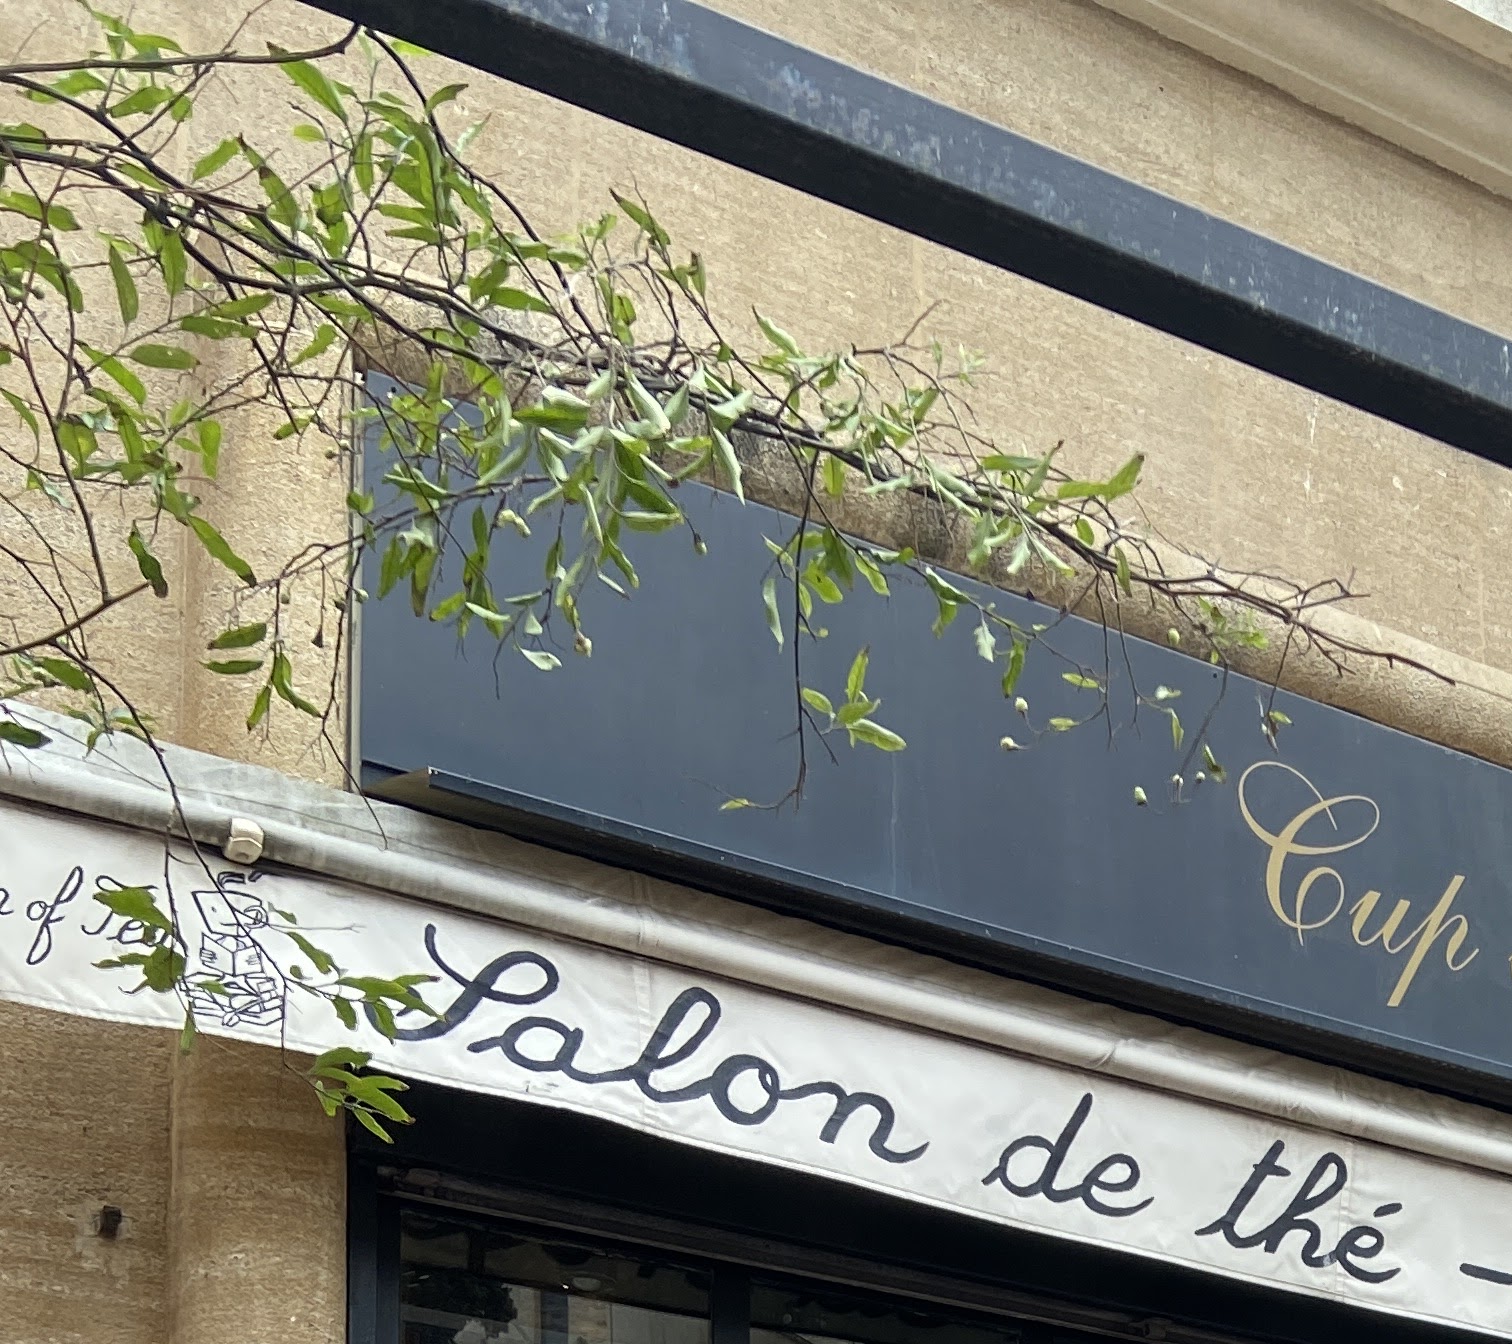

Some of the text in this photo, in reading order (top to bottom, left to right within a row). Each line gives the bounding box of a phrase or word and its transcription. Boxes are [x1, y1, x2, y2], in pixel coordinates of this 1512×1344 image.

[26, 865, 83, 965] of
[1238, 761, 1479, 1007] Cup
[366, 923, 929, 1164] Salon
[983, 1093, 1153, 1216] de
[1197, 1140, 1404, 1284] thé
